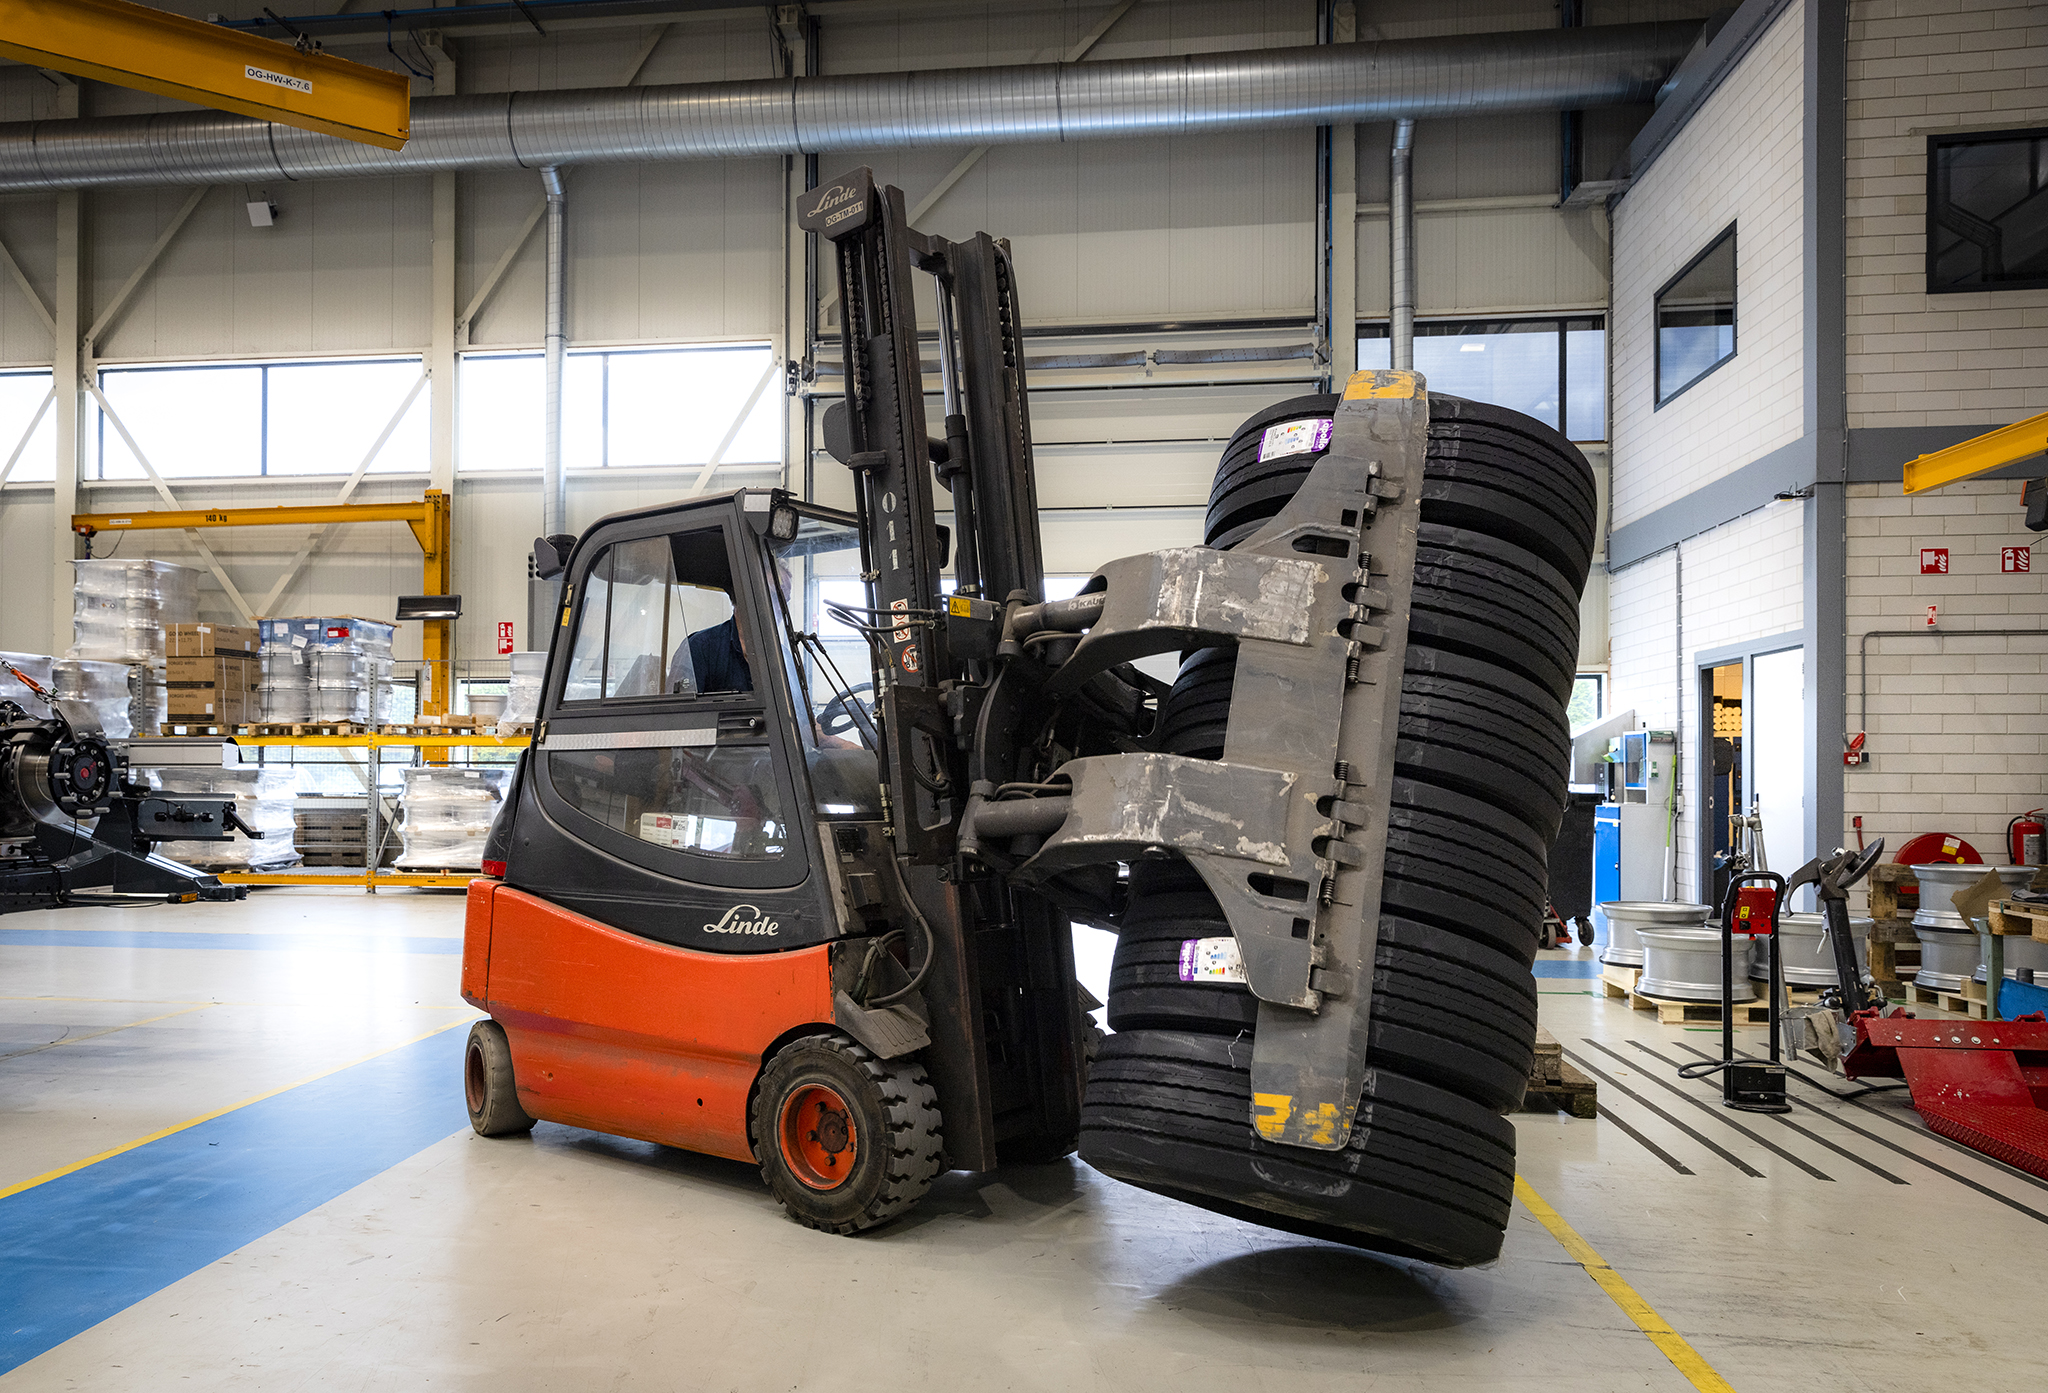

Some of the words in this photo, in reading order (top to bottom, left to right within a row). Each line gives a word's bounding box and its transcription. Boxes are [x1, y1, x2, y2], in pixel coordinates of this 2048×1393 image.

[247, 68, 310, 91] OG-HW-K-7.6
[806, 185, 857, 218] Linde
[826, 202, 863, 226] OG-TM-011
[1318, 422, 1330, 449] apollo
[205, 514, 216, 522] 140
[703, 904, 779, 936] Linde
[1182, 942, 1191, 976] apollo
